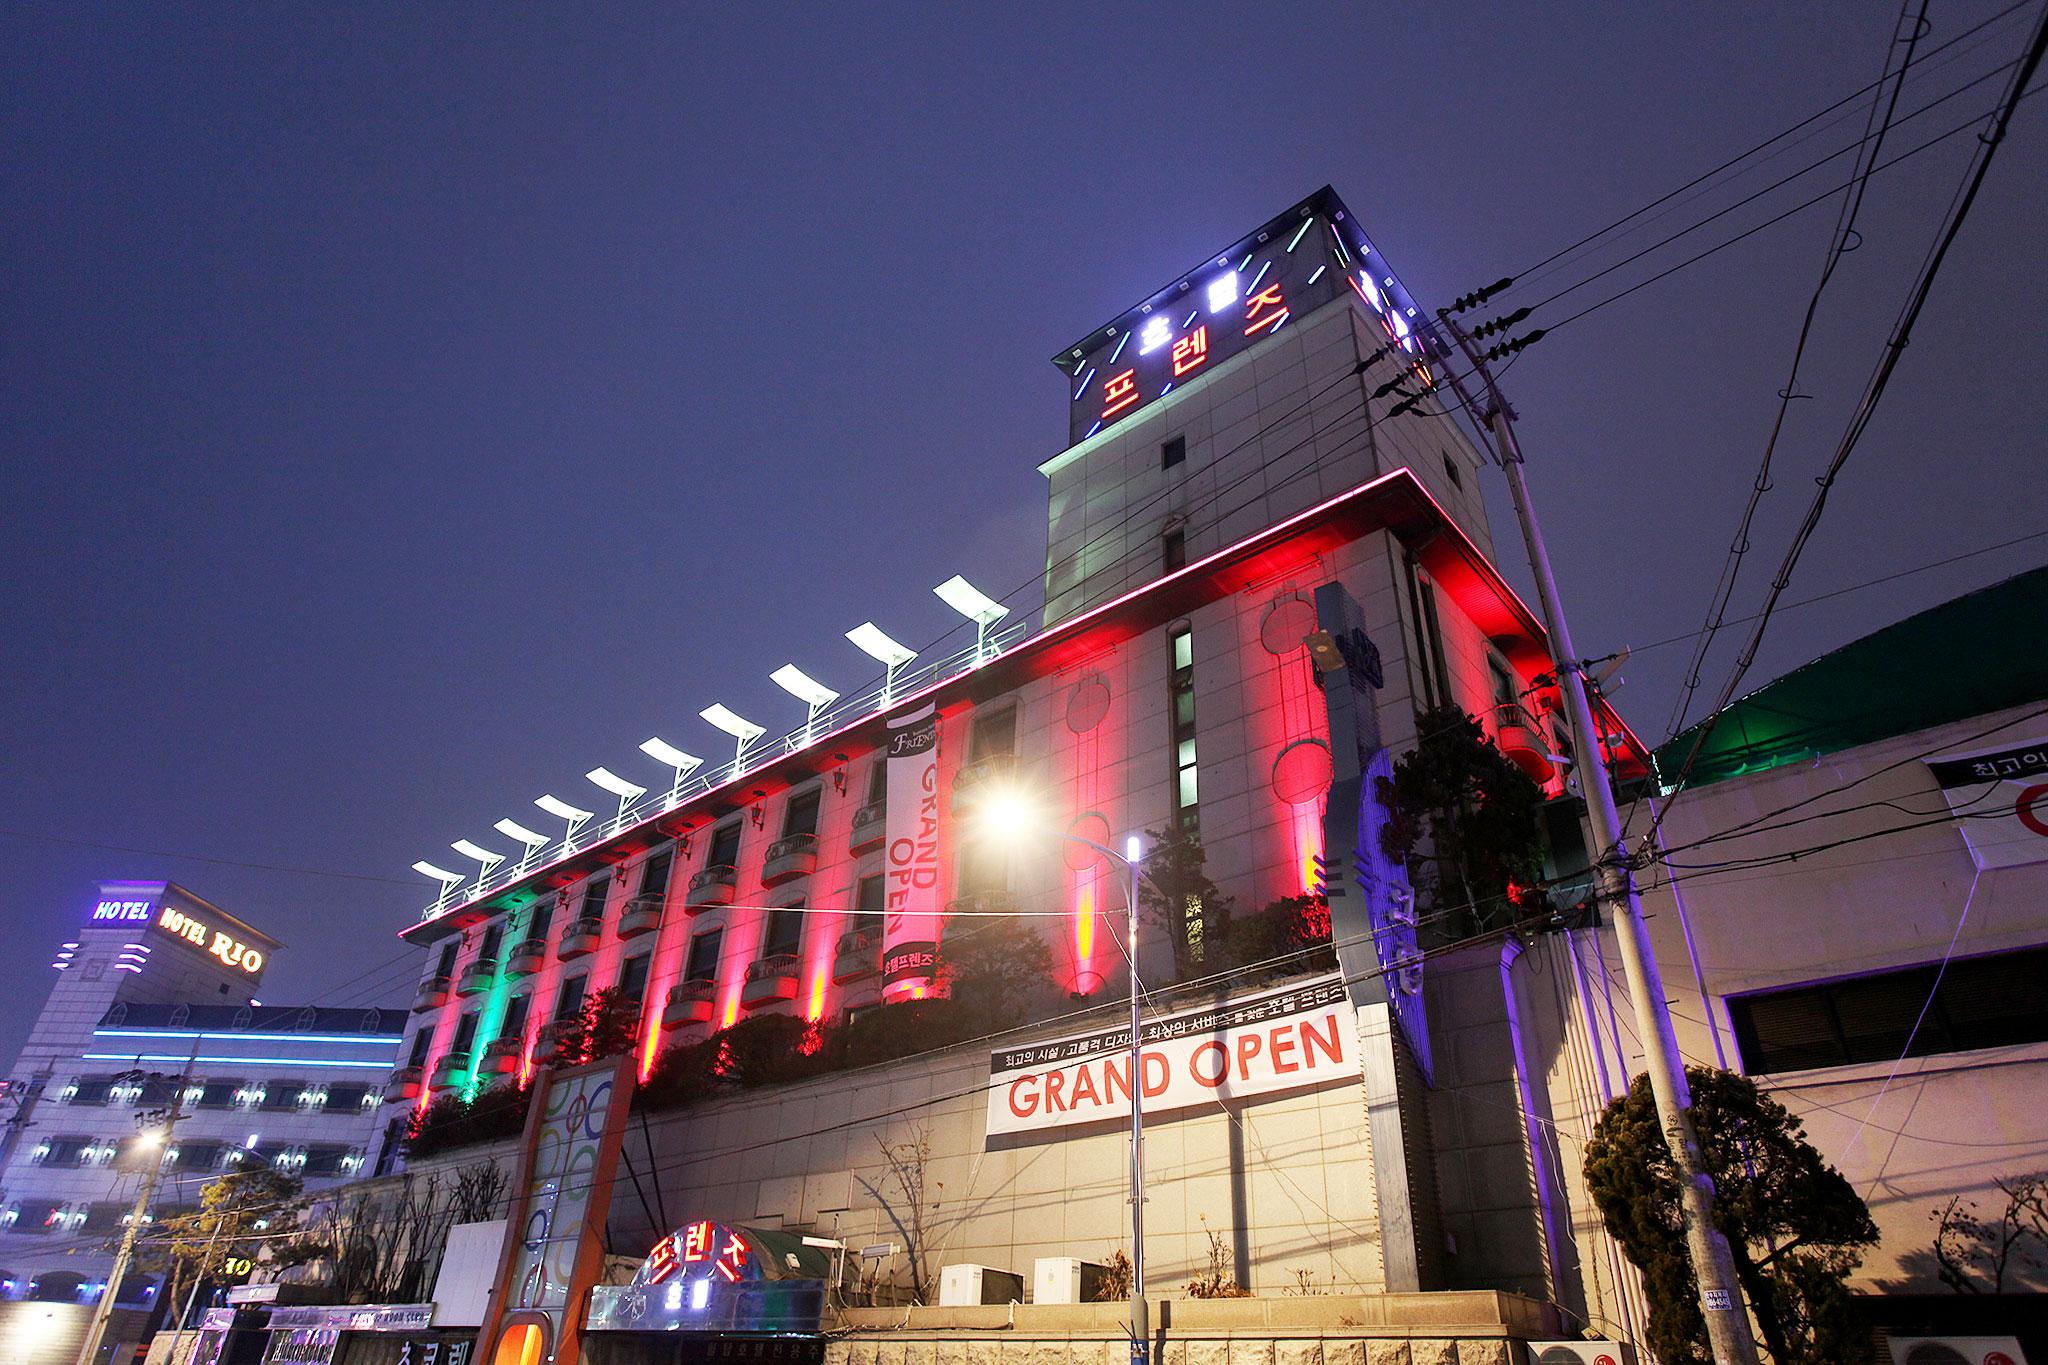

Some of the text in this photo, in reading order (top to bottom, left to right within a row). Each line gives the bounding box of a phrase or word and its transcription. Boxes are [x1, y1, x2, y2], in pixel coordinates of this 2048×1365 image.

[1100, 282, 1290, 419] 프렌즈
[912, 763, 936, 889] GRAND
[92, 901, 150, 920] HOTEL
[888, 837, 914, 937] OPEN
[158, 906, 263, 974] HOTEL RIO
[1005, 1051, 1035, 1067] 최고의
[1037, 1048, 1059, 1062] 시설
[1067, 1038, 1102, 1057] 고품격
[1008, 1014, 1344, 1118] GRAND OPEN
[650, 1220, 752, 1285] 프렌즈
